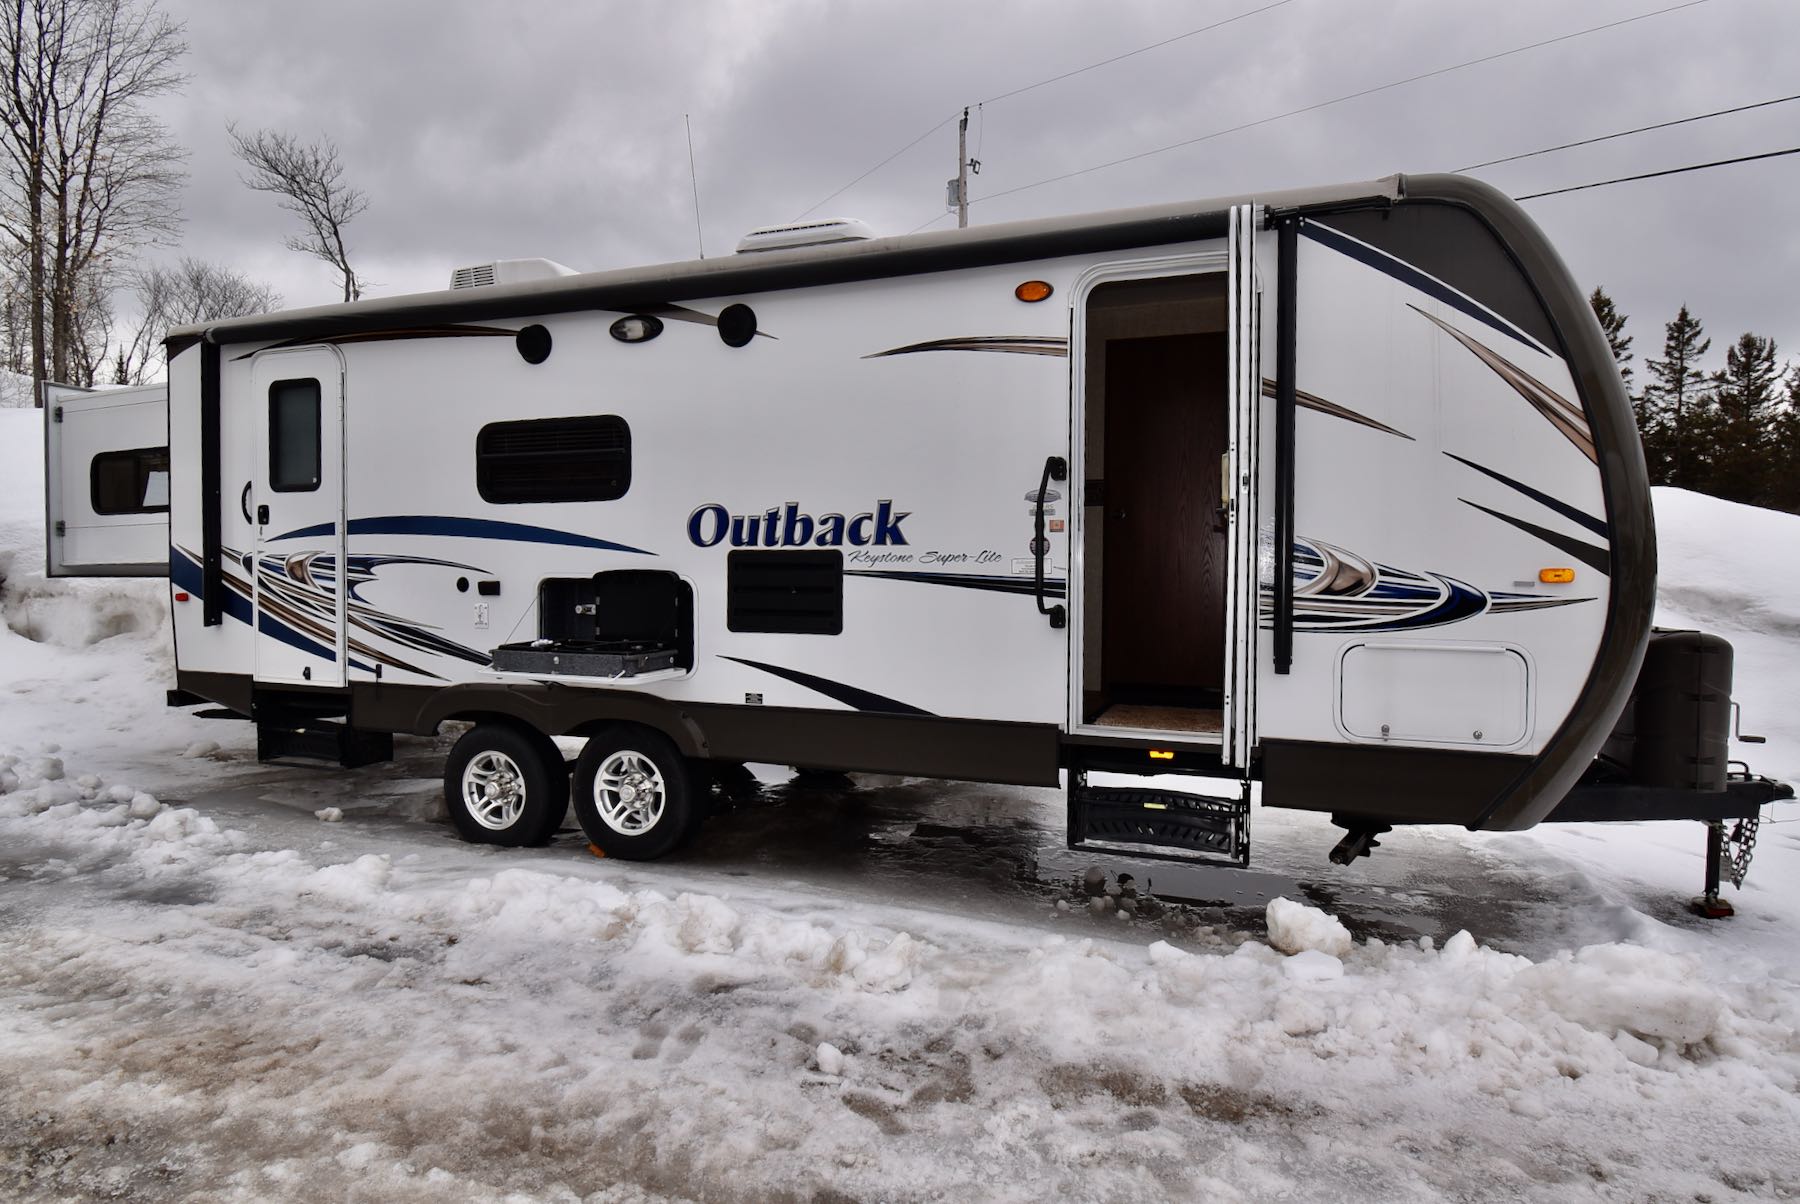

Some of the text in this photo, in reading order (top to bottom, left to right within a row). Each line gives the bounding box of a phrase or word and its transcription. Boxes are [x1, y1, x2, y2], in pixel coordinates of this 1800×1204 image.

[687, 499, 912, 547] Outback
[848, 550, 914, 567] Keystone
[919, 550, 1002, 566] Super-Lite
